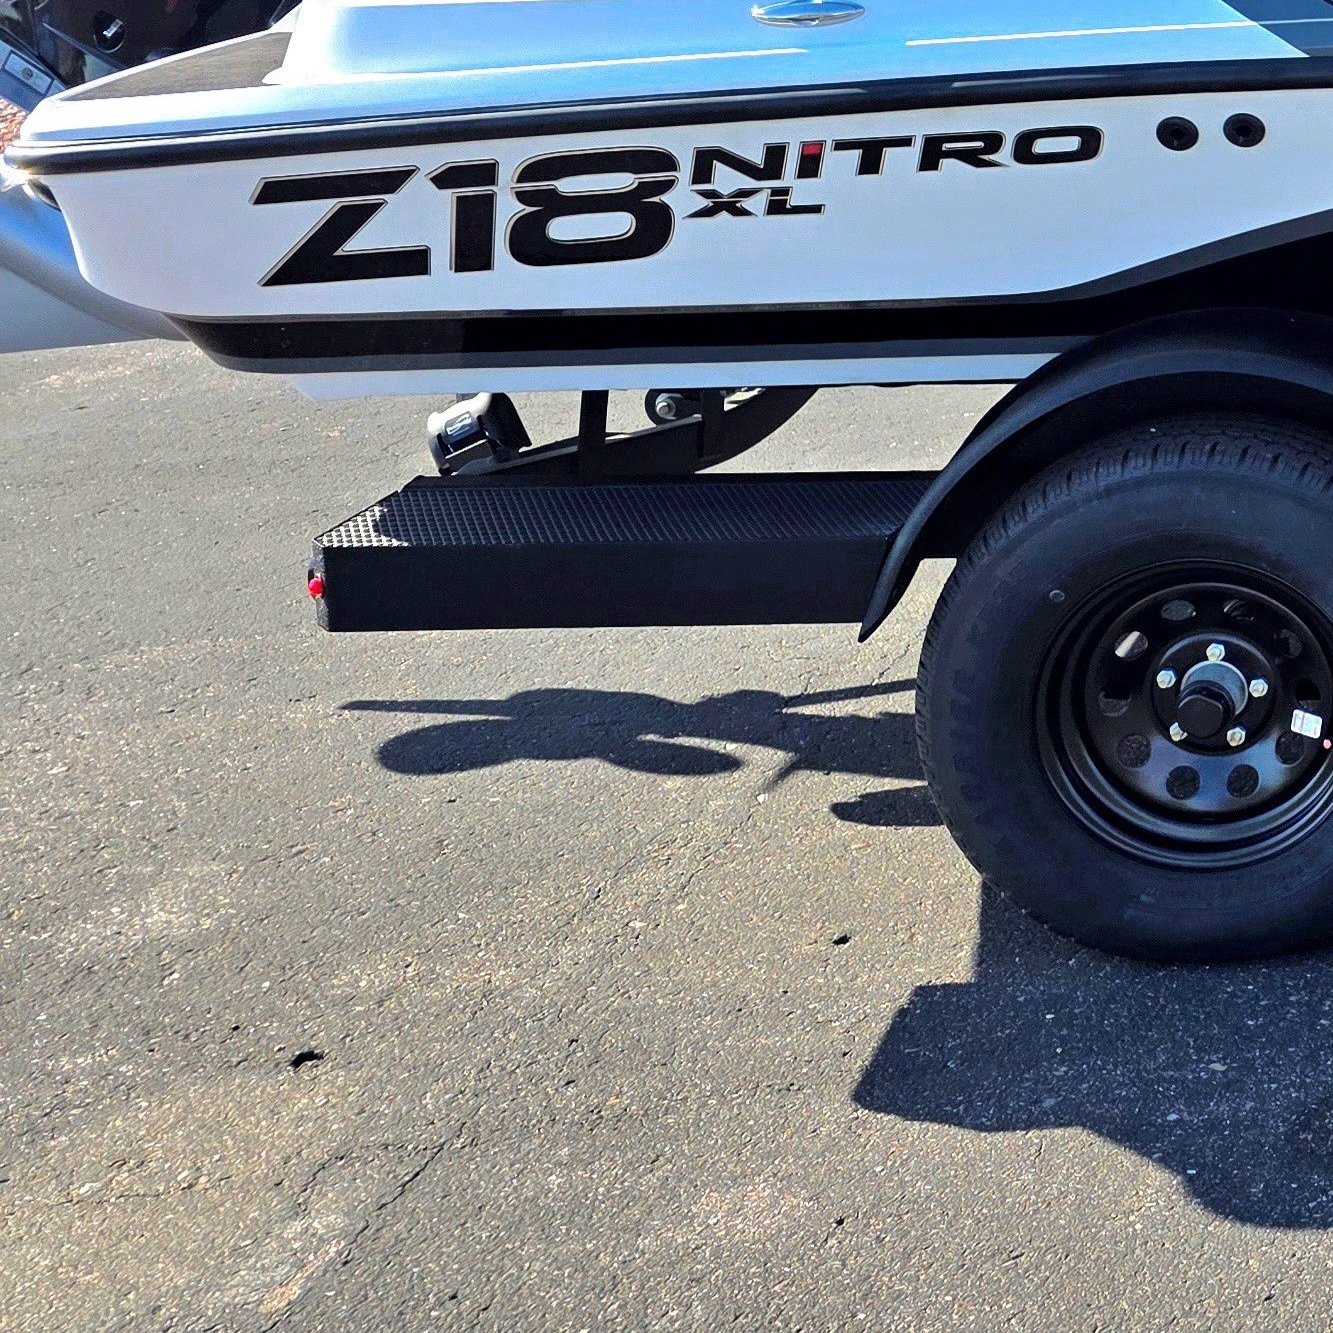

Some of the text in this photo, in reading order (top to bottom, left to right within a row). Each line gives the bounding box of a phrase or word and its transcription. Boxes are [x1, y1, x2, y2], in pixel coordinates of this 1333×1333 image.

[688, 125, 1105, 186] NITRO
[248, 145, 681, 287] Z18
[682, 186, 826, 220] XL
